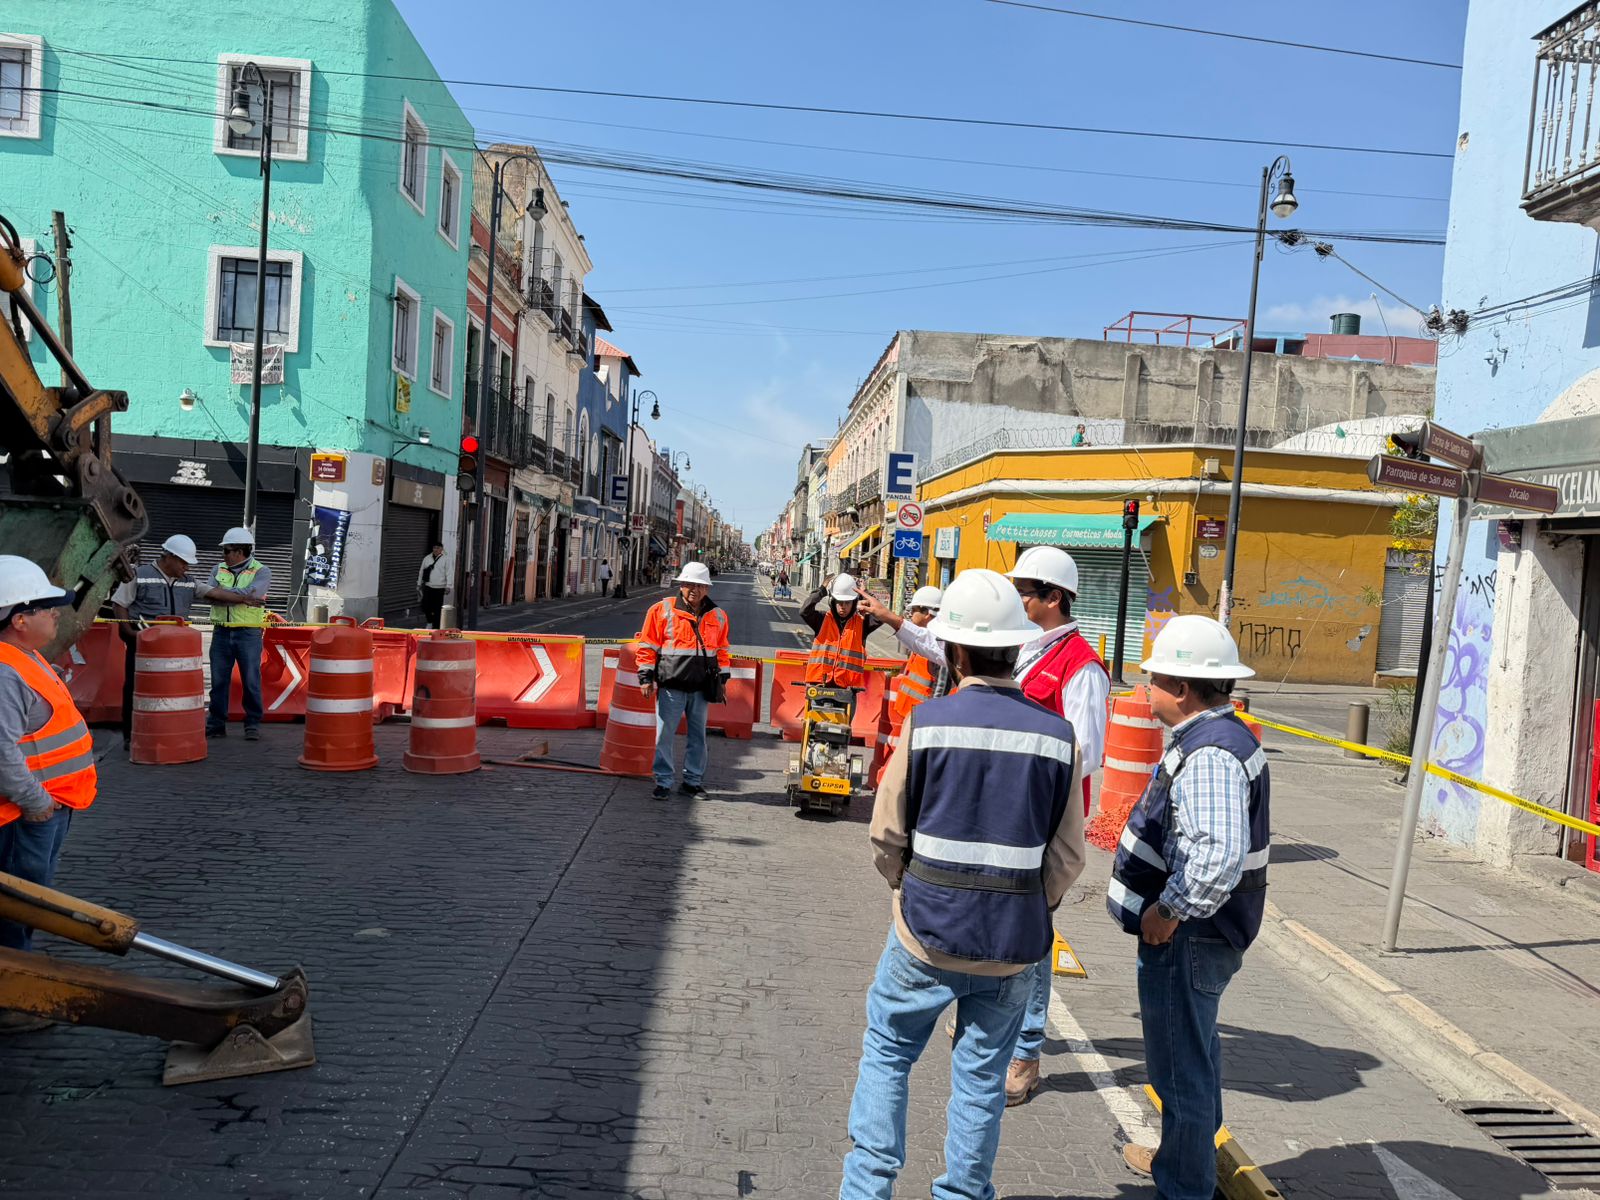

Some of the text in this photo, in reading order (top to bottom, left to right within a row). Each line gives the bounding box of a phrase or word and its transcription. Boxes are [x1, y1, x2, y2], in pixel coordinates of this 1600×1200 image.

[887, 453, 914, 494] E
[1418, 471, 1428, 483] de
[1428, 474, 1441, 485] San
[1441, 476, 1457, 488] José
[611, 476, 628, 501] E
[1509, 488, 1530, 501] Zócalo
[886, 493, 912, 501] PANDAL
[632, 515, 645, 527] WC
[822, 781, 844, 789] CIPSA
